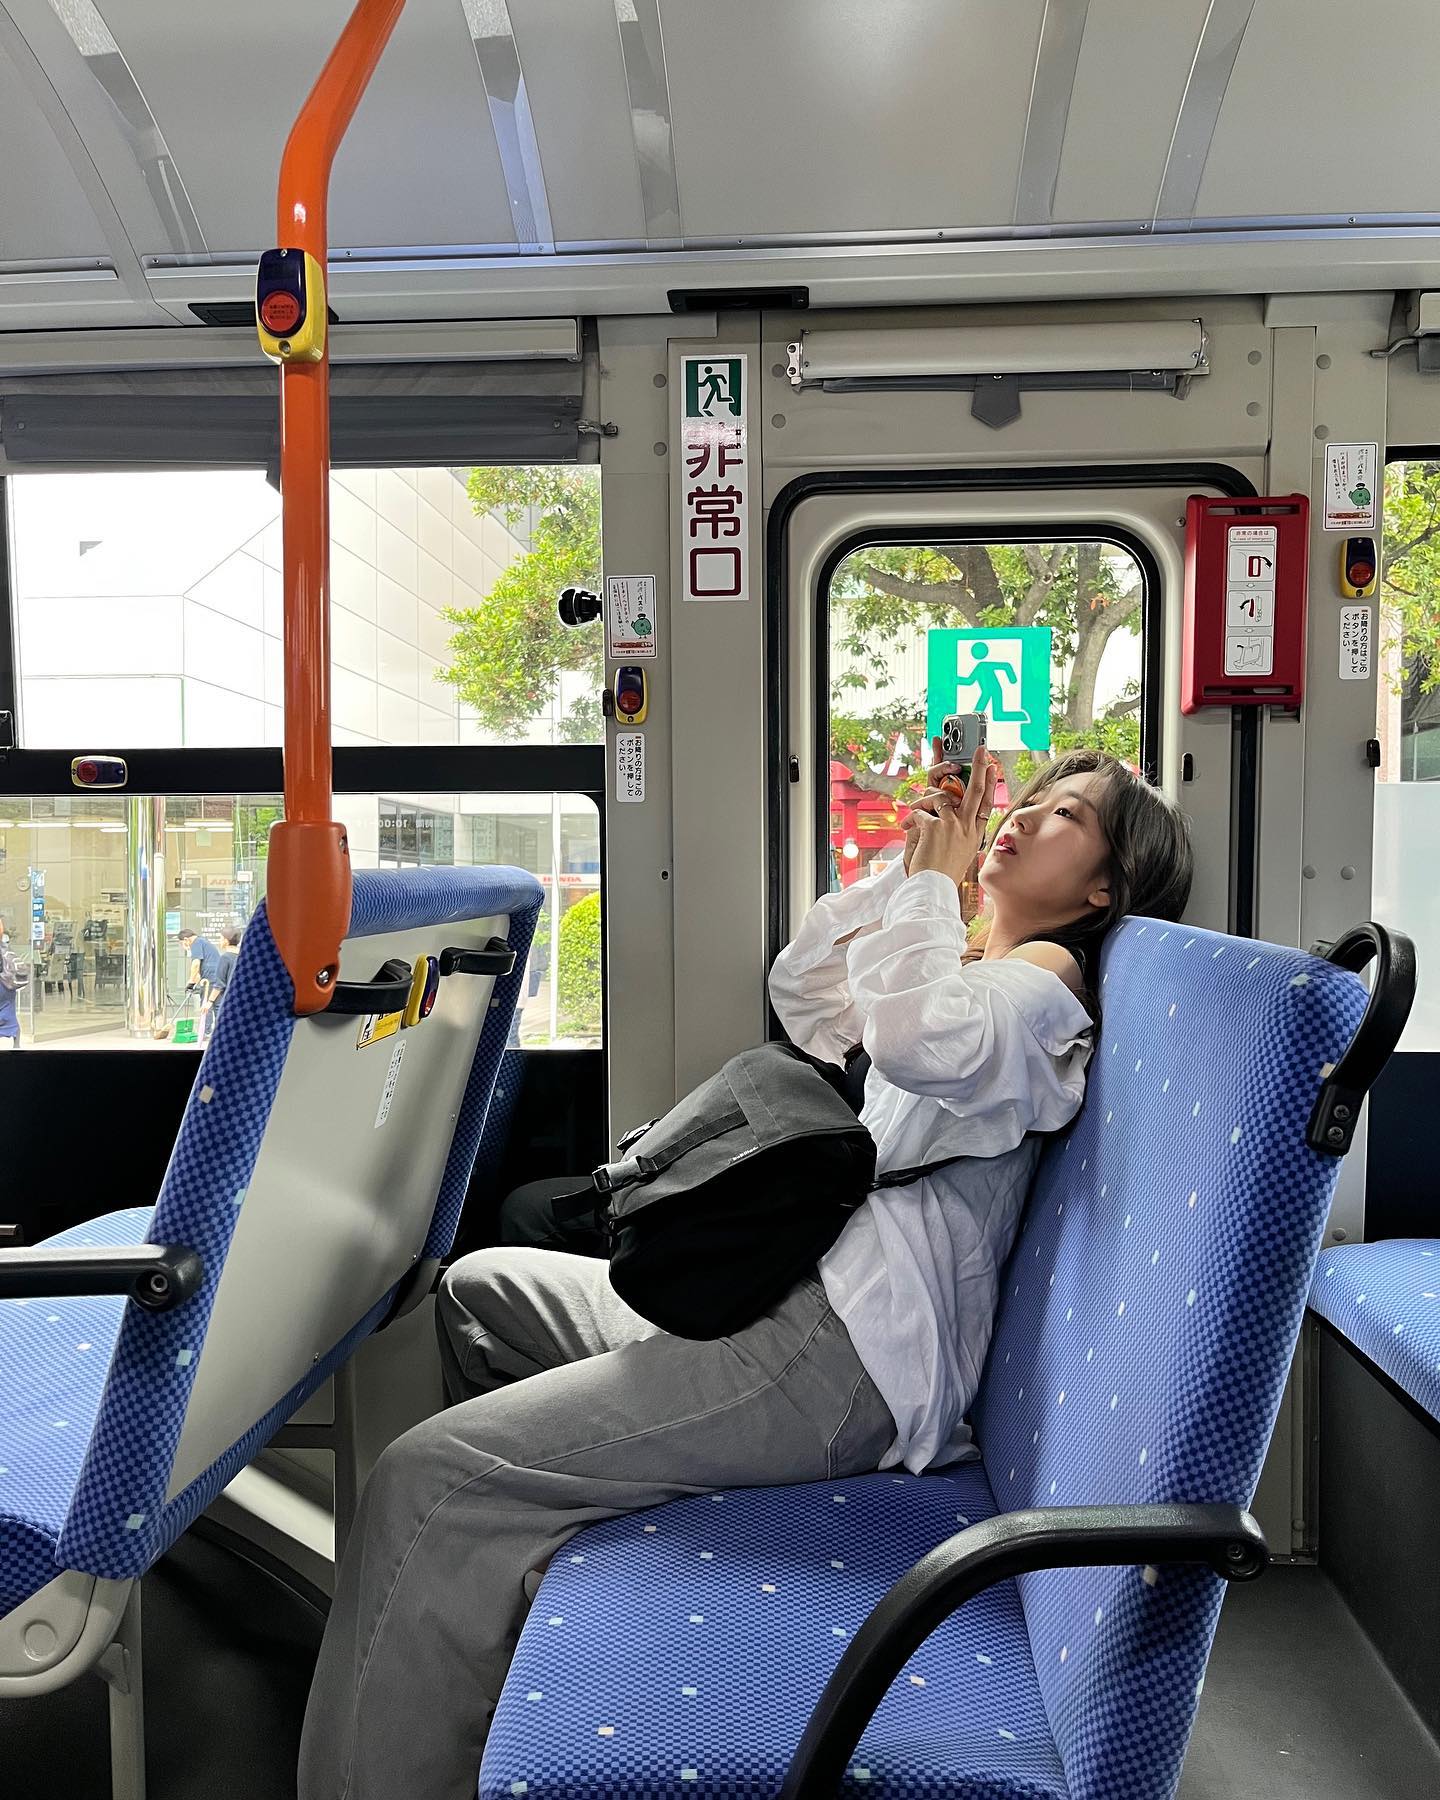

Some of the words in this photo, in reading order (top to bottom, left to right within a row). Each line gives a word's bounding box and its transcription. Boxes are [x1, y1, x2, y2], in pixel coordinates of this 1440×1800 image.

[686, 422, 743, 596] 非常口
[1351, 613, 1360, 673] ボタンを押して
[1359, 613, 1369, 673] お降りの方はこの
[635, 739, 643, 797] お降りの方はこの
